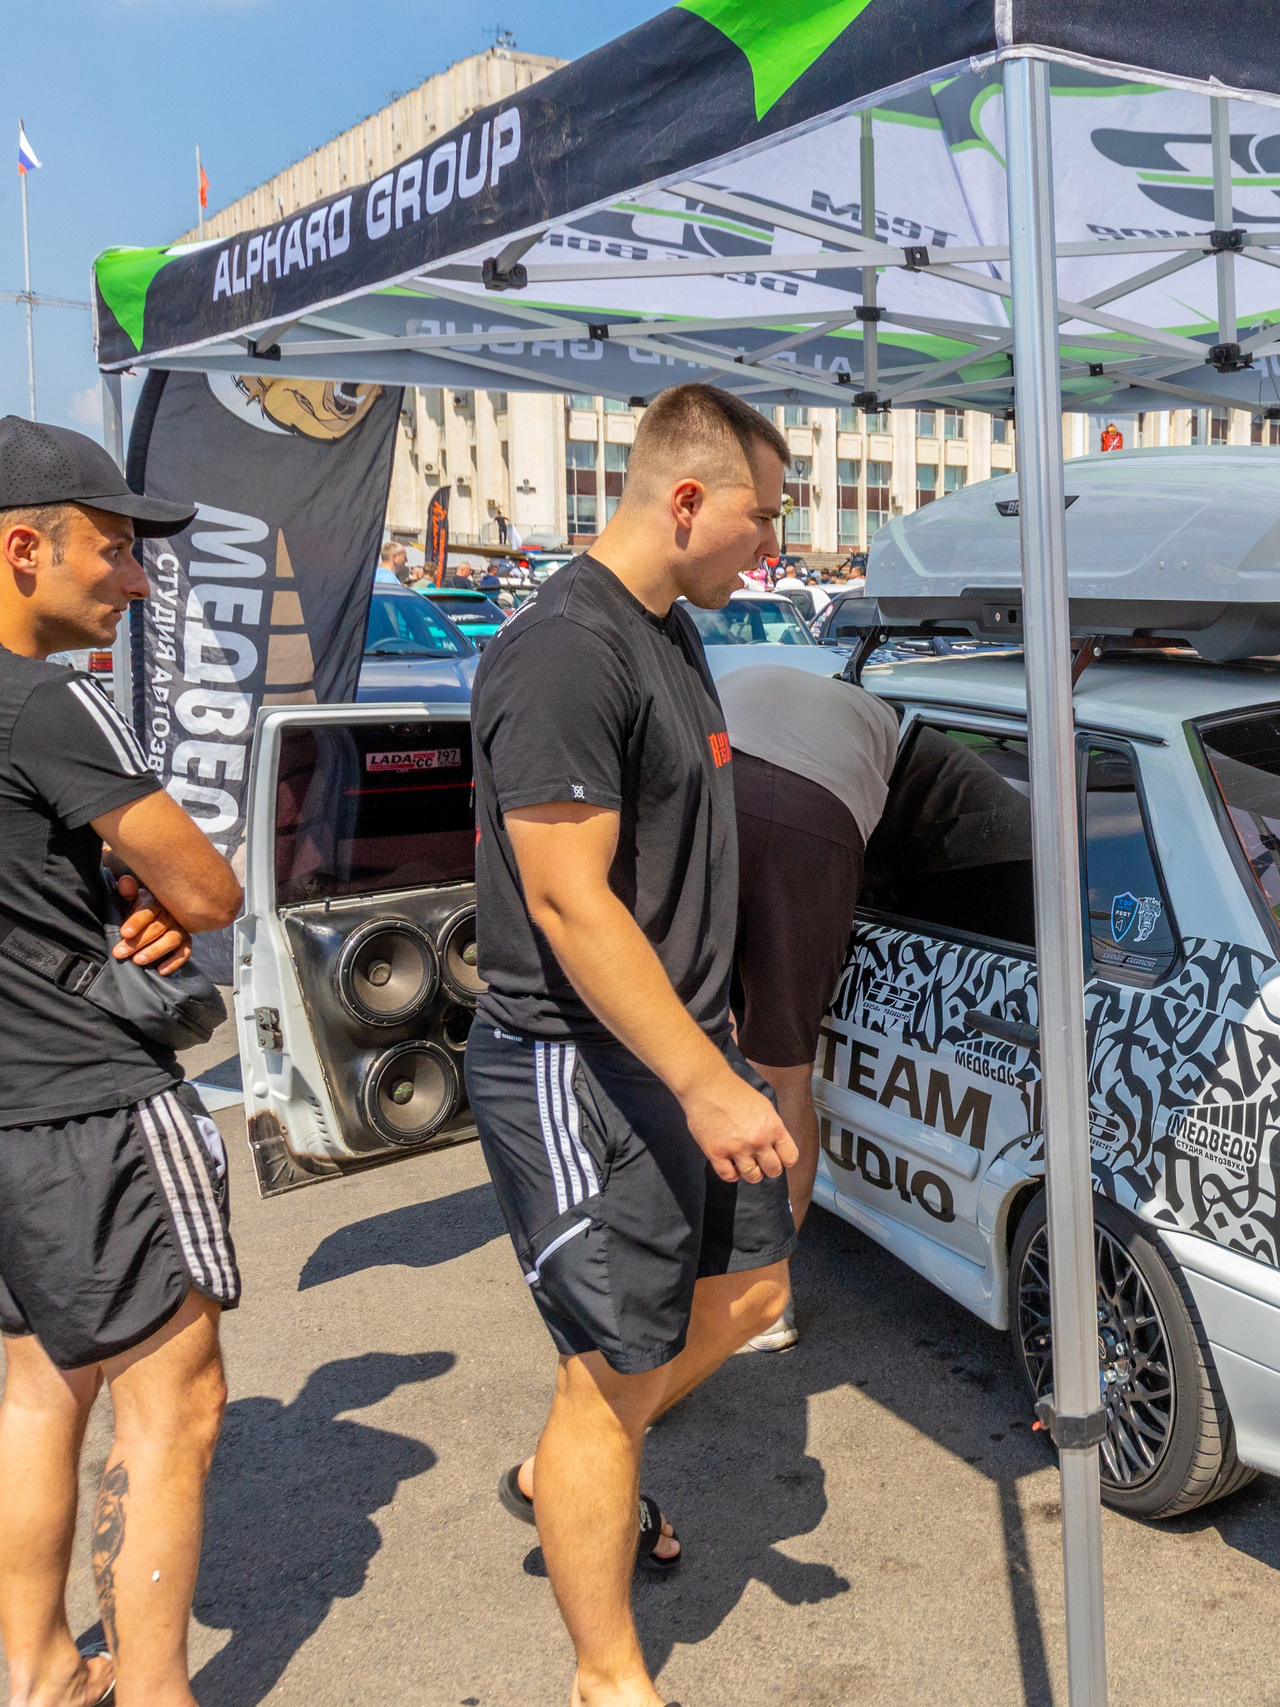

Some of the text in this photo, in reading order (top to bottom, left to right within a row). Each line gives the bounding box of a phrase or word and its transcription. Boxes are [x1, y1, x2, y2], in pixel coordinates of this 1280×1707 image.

[213, 106, 521, 301] ALPHARD GROUP
[148, 553, 180, 781] СТУДИЯ АВТОЗВ
[165, 502, 270, 857] МЕДВЕД
[819, 1024, 993, 1151] TEAM
[1166, 1113, 1256, 1165] МЕДВЕДЬ
[820, 1116, 956, 1223] UDIO
[1176, 1139, 1246, 1172] СТУДИЯ АВТОЗВУКА
